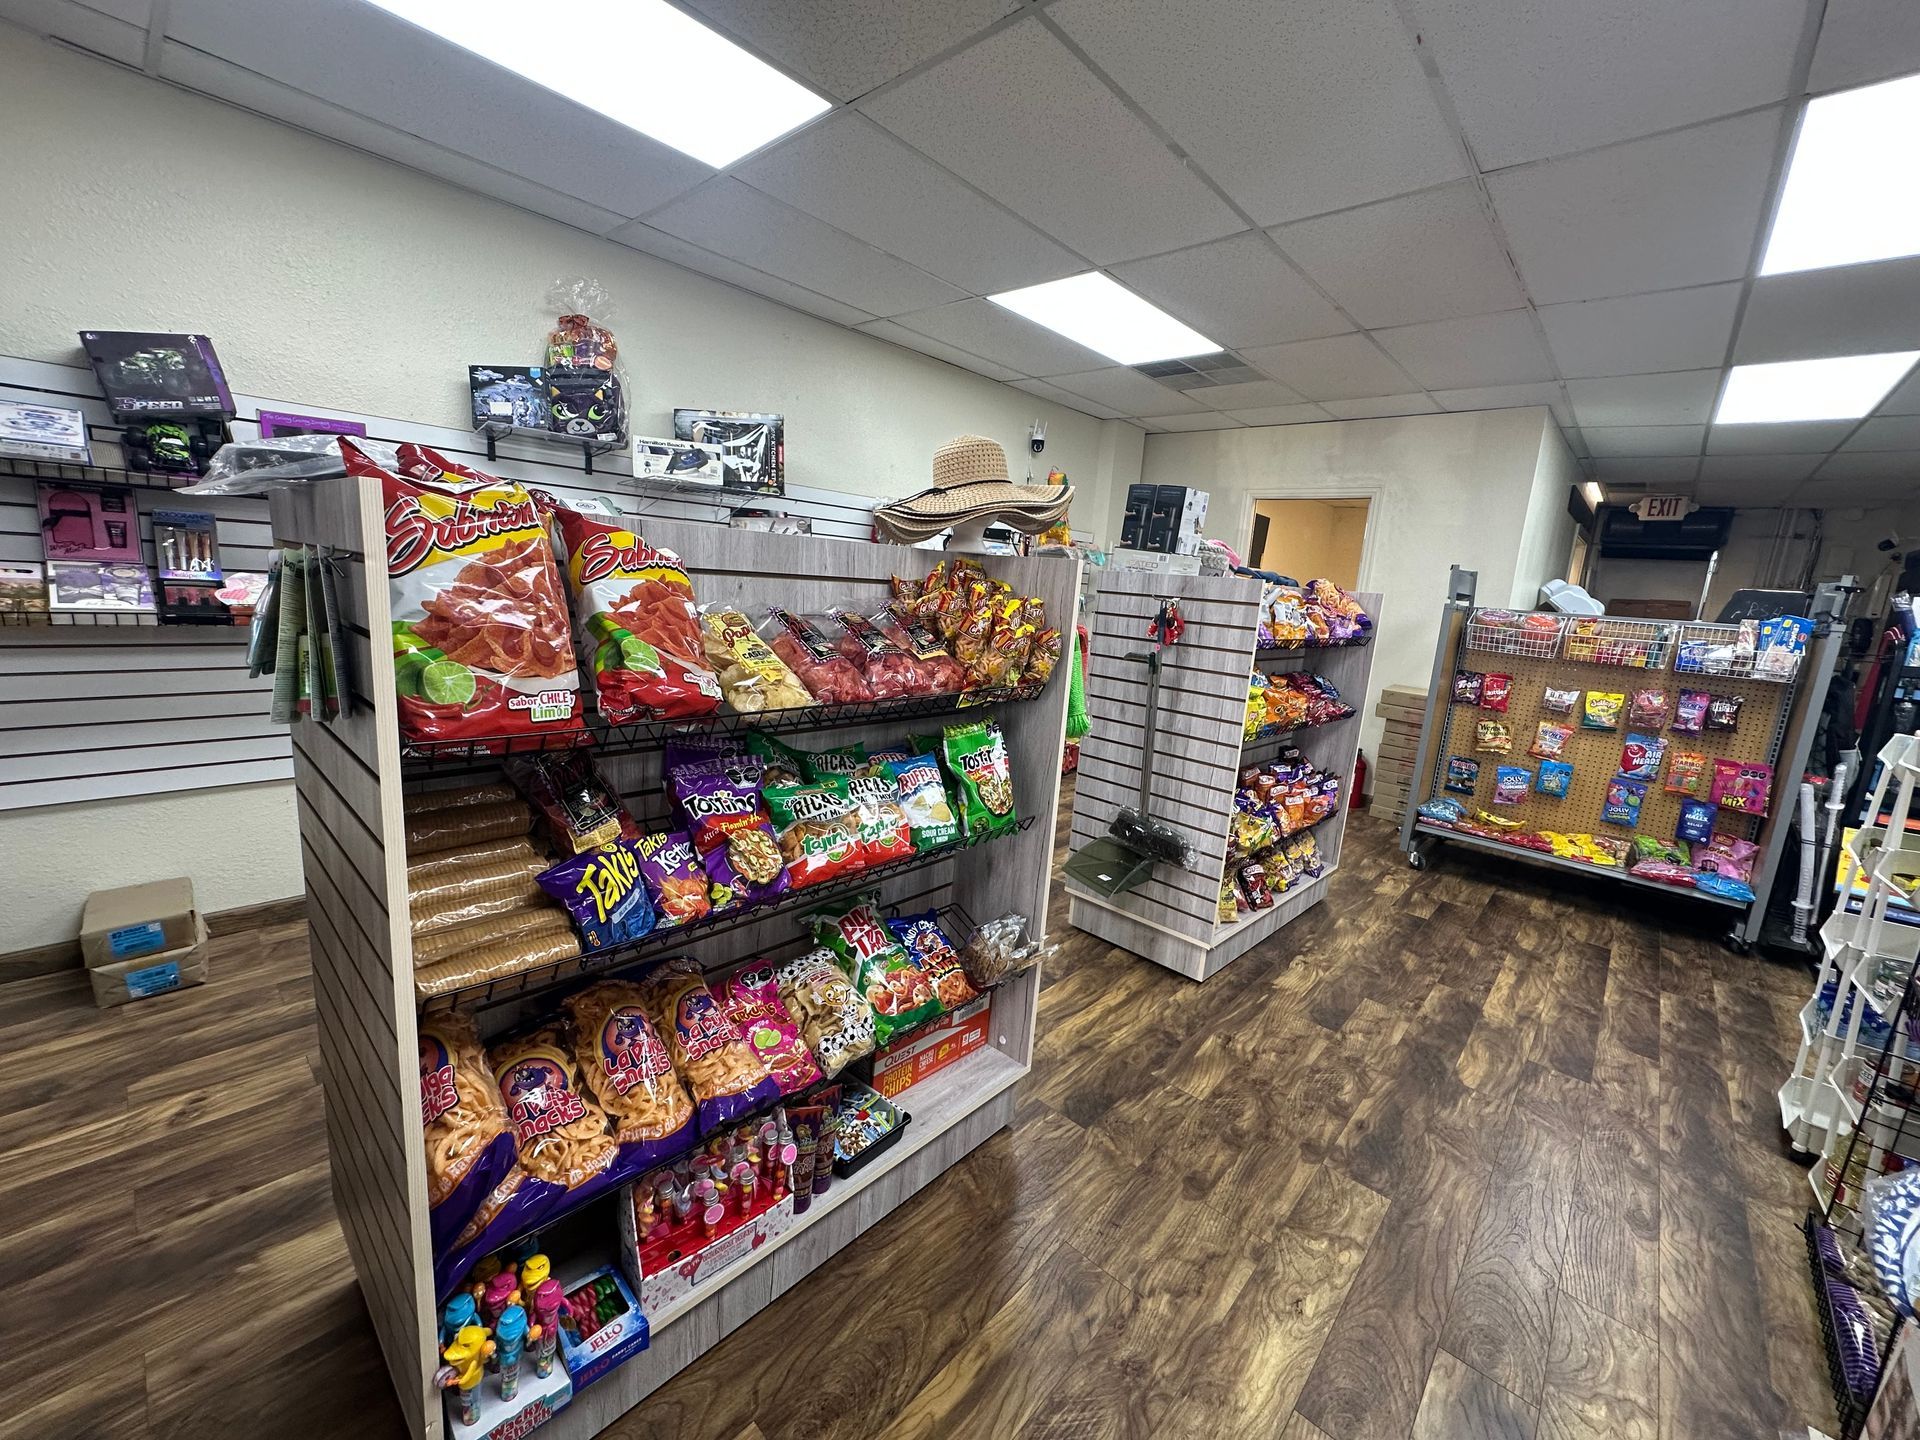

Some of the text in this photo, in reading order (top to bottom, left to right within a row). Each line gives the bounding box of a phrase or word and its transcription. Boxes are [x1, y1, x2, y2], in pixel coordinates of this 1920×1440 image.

[639, 439, 666, 447] Hamilton
[1647, 498, 1683, 517] EXIT
[510, 692, 575, 707] sabor CHILE y
[532, 706, 570, 719] Limón
[816, 753, 857, 771] RICAS
[1645, 751, 1662, 759] AIR
[848, 777, 891, 796] RICAS
[793, 792, 843, 820] RICAS
[1685, 813, 1709, 822] HALLS
[921, 826, 956, 838] SOUR CREAM
[634, 832, 668, 862] Takis
[576, 847, 639, 924] Takis
[676, 1024, 704, 1048] La
[603, 1050, 632, 1077] La
[884, 1045, 917, 1068] QUEST
[883, 1062, 913, 1086] PROTEIN
[882, 1074, 913, 1100] CHIPS
